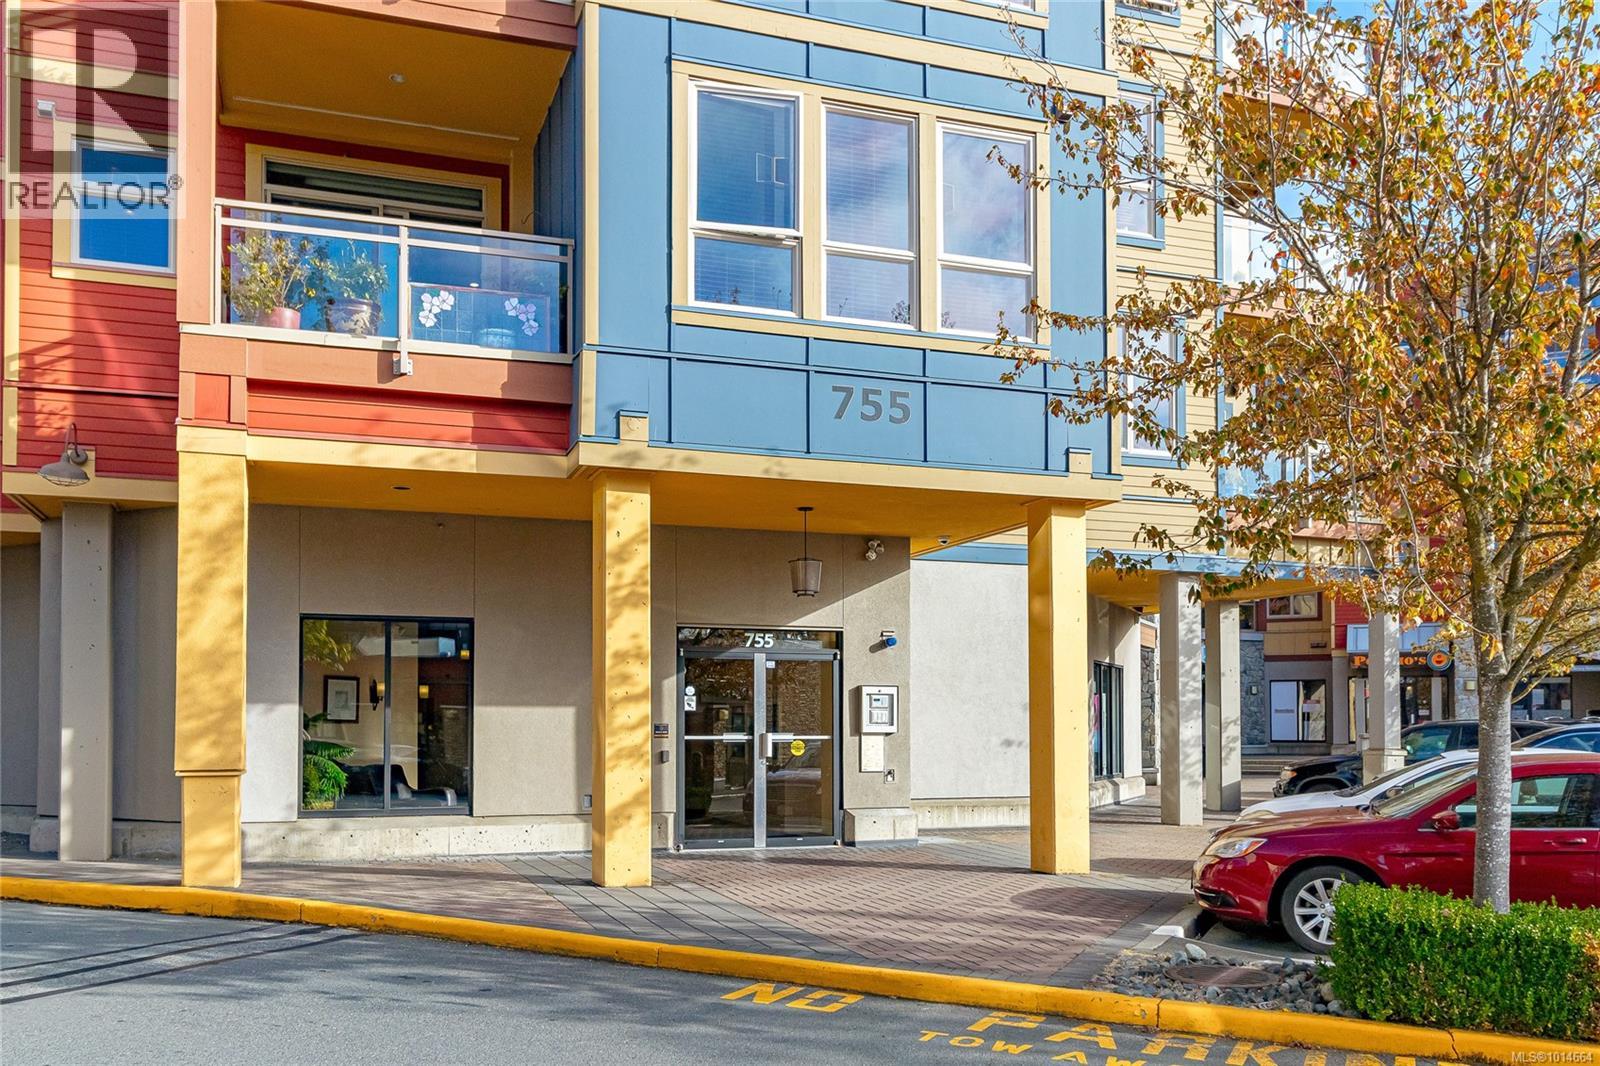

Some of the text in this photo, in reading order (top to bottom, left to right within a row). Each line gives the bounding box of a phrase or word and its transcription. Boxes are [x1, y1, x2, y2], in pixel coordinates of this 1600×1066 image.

[832, 385, 911, 424] 755
[744, 632, 774, 648] 755
[720, 982, 865, 1013] NO
[918, 1030, 1034, 1055] TOW
[966, 1011, 1471, 1066] PARKI
